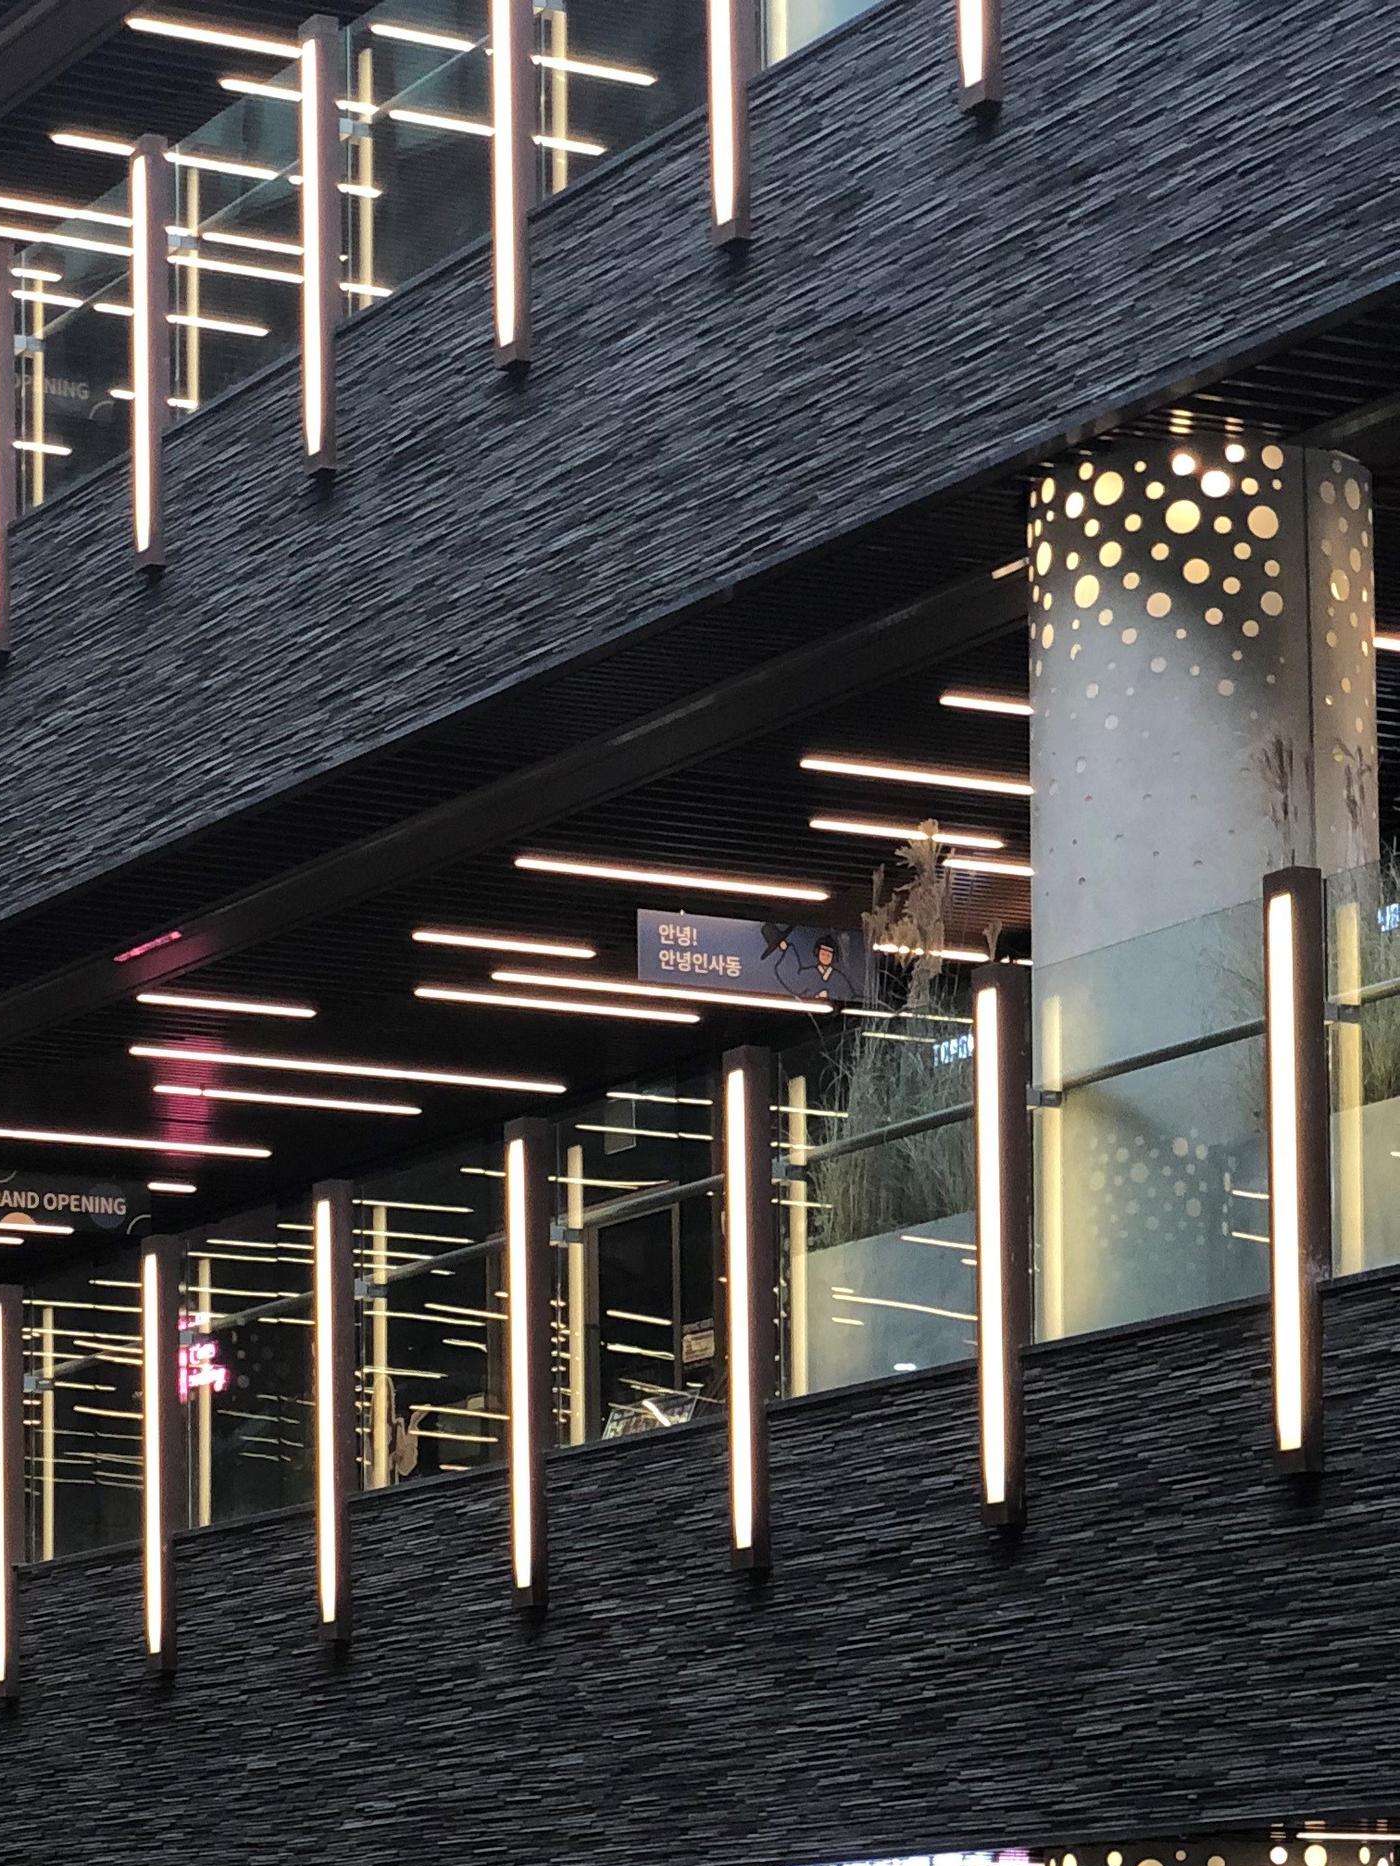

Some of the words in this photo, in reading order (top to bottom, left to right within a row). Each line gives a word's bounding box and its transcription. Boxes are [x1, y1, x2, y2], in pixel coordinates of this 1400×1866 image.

[658, 923, 698, 947] 안녕!
[658, 949, 742, 977] 안녕인사동
[43, 1192, 127, 1215] OPENING
